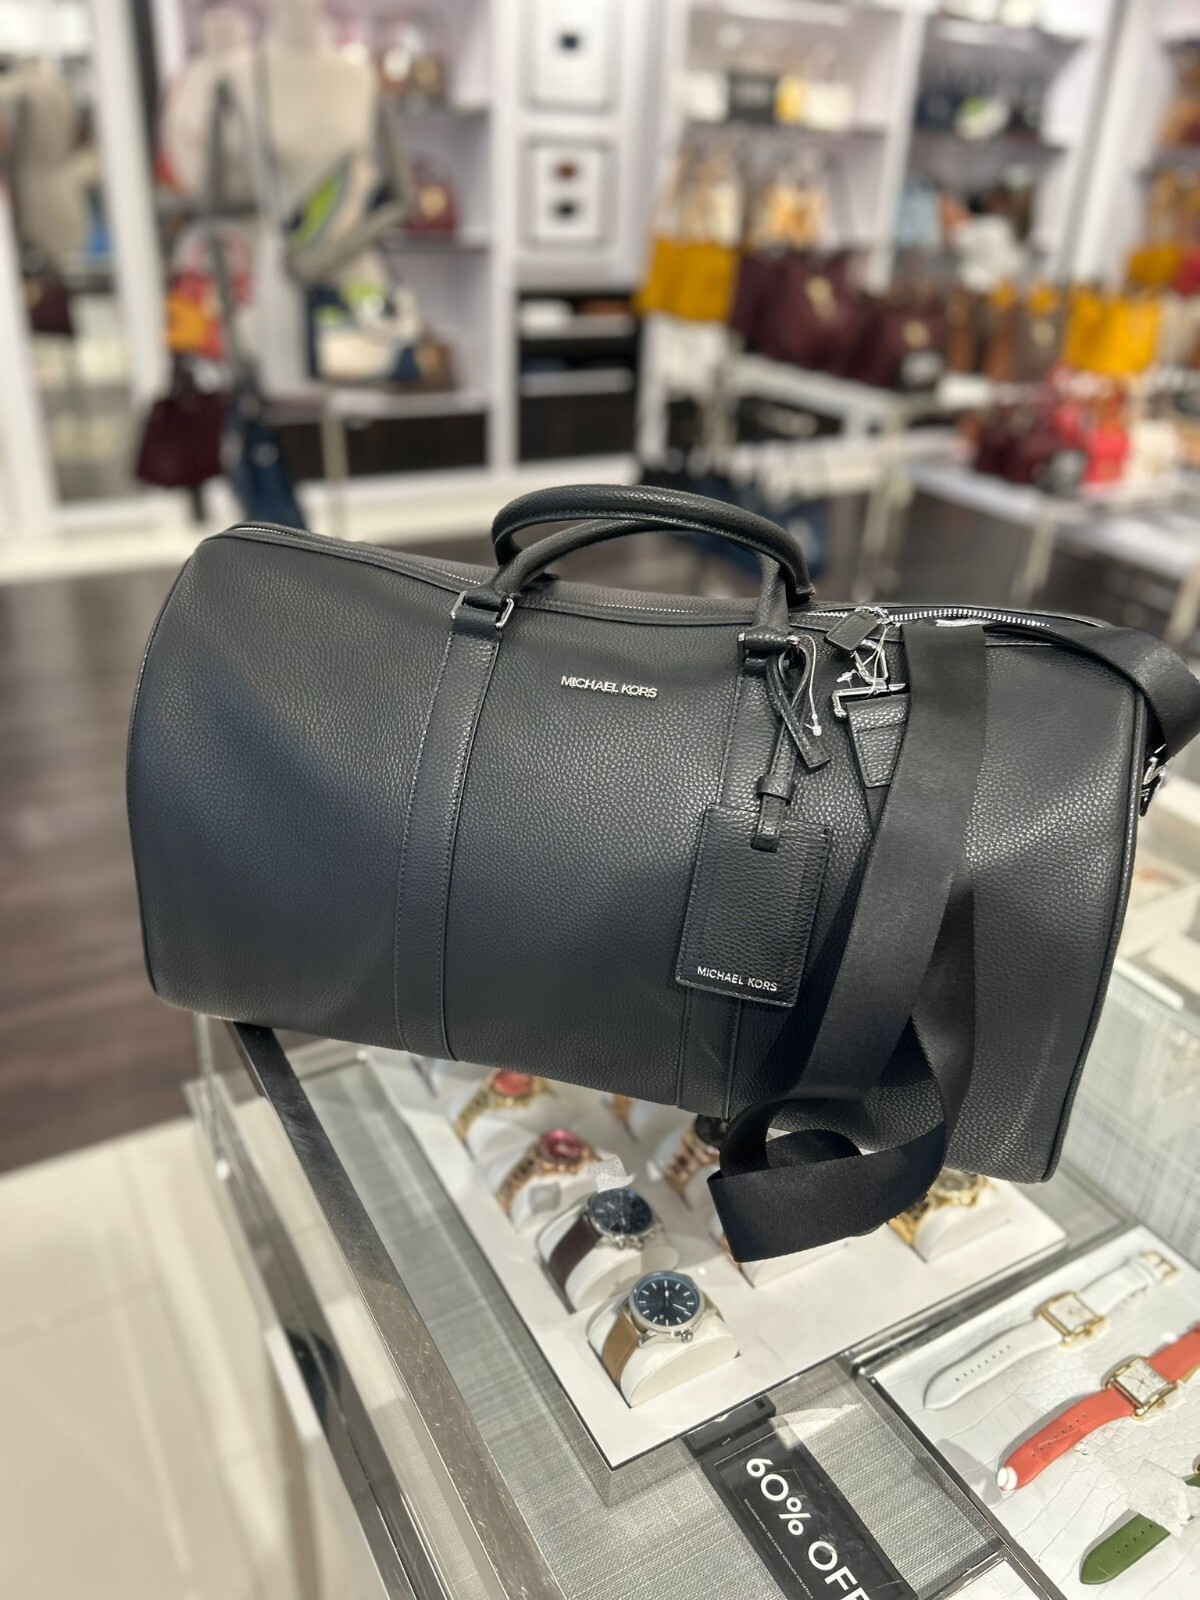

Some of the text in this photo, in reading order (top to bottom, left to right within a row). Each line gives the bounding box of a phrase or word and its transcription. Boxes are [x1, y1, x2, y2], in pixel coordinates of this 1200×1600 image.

[560, 675, 658, 698] MICHAEL KORS
[697, 966, 778, 992] MICHAEL KORS
[746, 1458, 812, 1536] 60%
